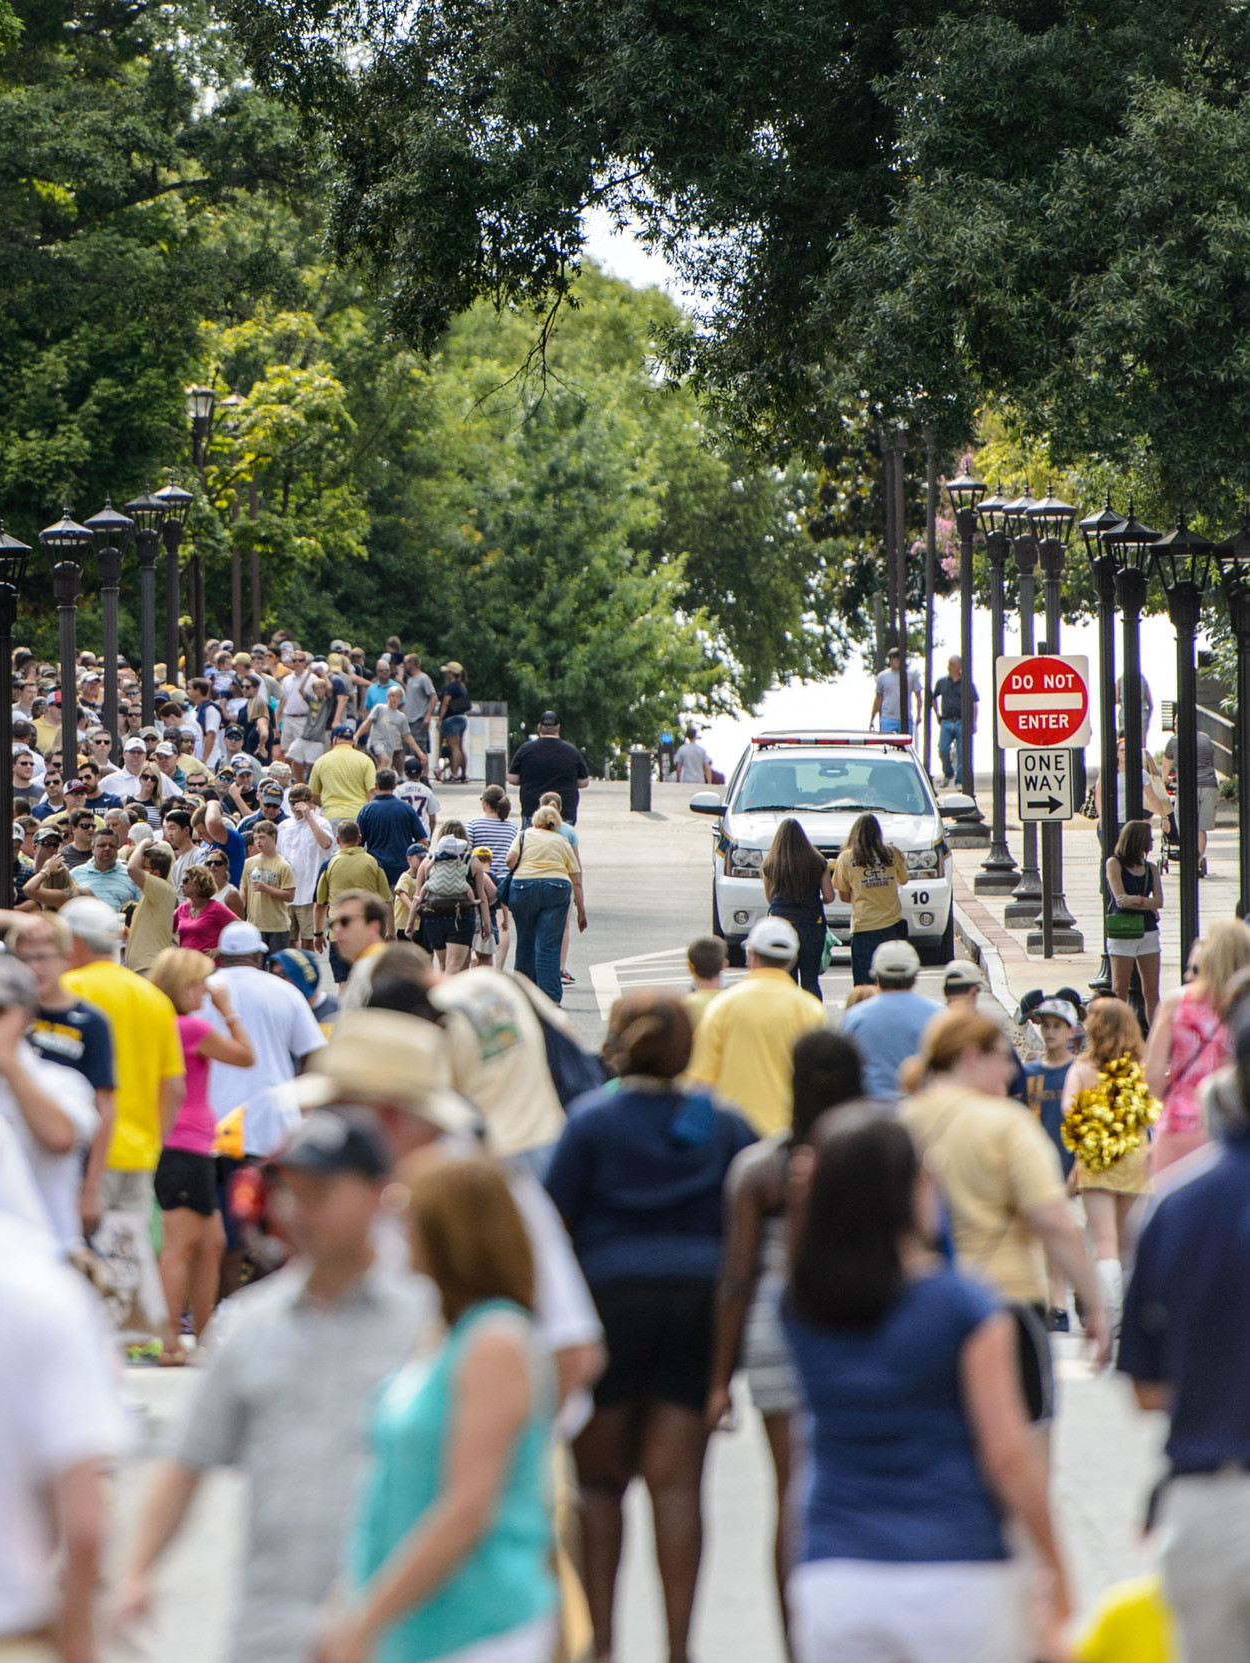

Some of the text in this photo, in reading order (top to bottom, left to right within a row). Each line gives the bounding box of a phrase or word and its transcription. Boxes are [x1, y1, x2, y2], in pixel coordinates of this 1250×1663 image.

[1011, 673, 1075, 690] DO NOT
[1018, 714, 1069, 730] ENTER
[1024, 754, 1065, 772] ONE
[1023, 774, 1066, 792] WAY
[911, 891, 930, 905] 10
